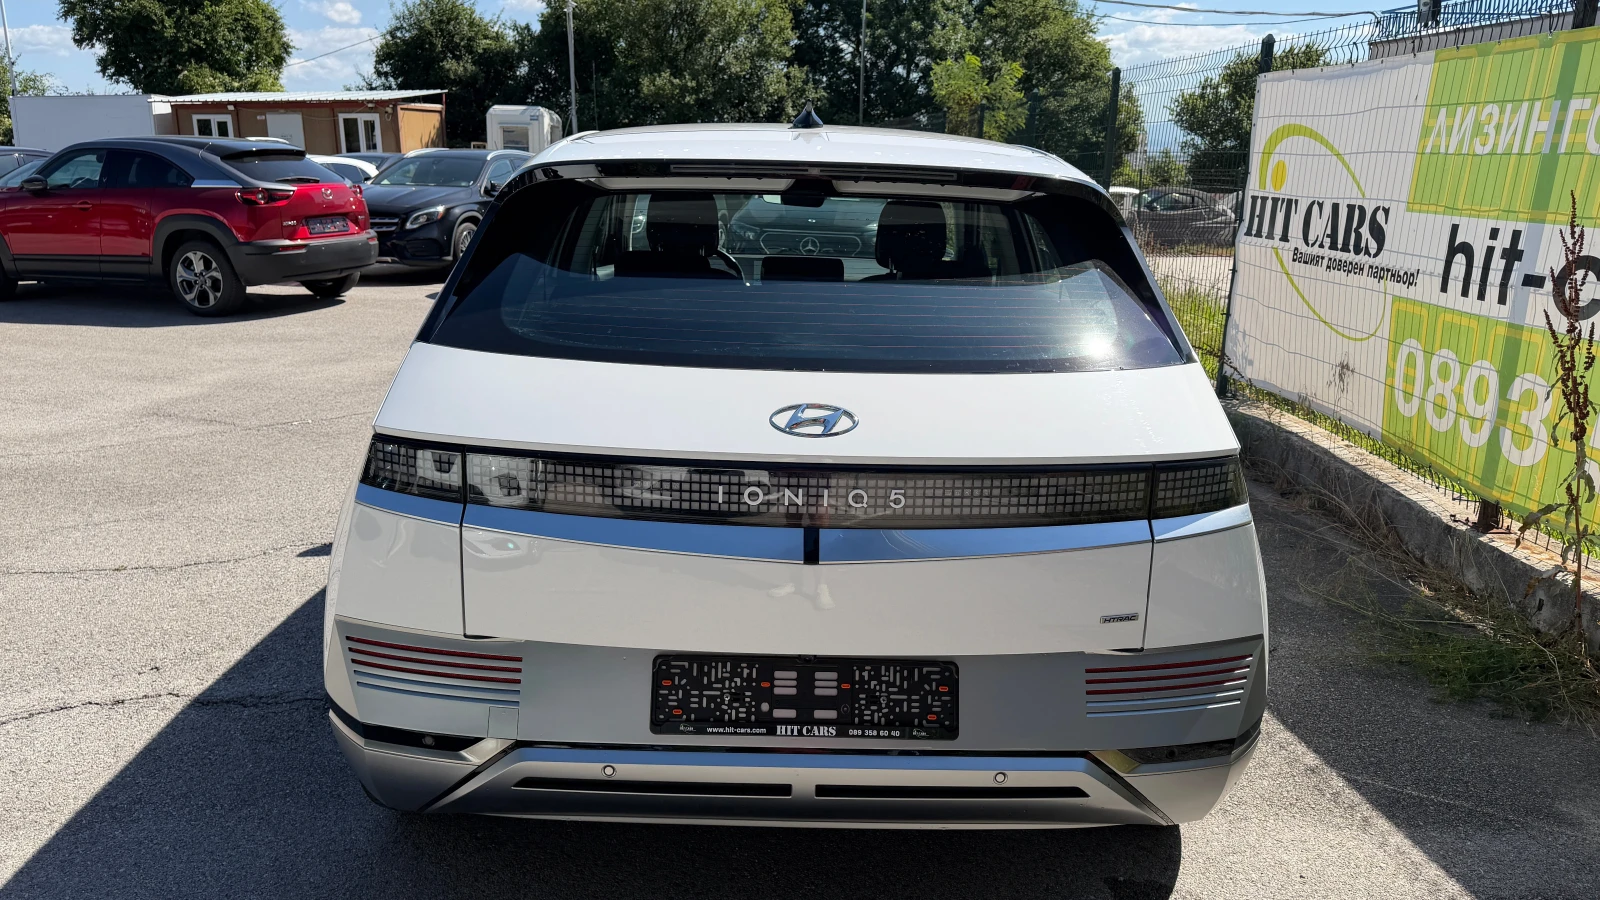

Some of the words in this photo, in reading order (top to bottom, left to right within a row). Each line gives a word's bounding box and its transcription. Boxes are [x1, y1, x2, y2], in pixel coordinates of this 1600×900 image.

[1243, 194, 1299, 243] HIT
[1302, 199, 1391, 259] CARS
[1291, 246, 1326, 268] Вашият
[1325, 258, 1366, 277] доверен
[1366, 264, 1420, 289] партньор!
[1394, 337, 1553, 467] 0893
[1103, 614, 1137, 624] HTRAC
[706, 726, 767, 734] www.hit-cars.com
[776, 725, 801, 736] HIT
[802, 725, 837, 737] CARS
[864, 729, 878, 737] 358
[879, 729, 889, 737] 60
